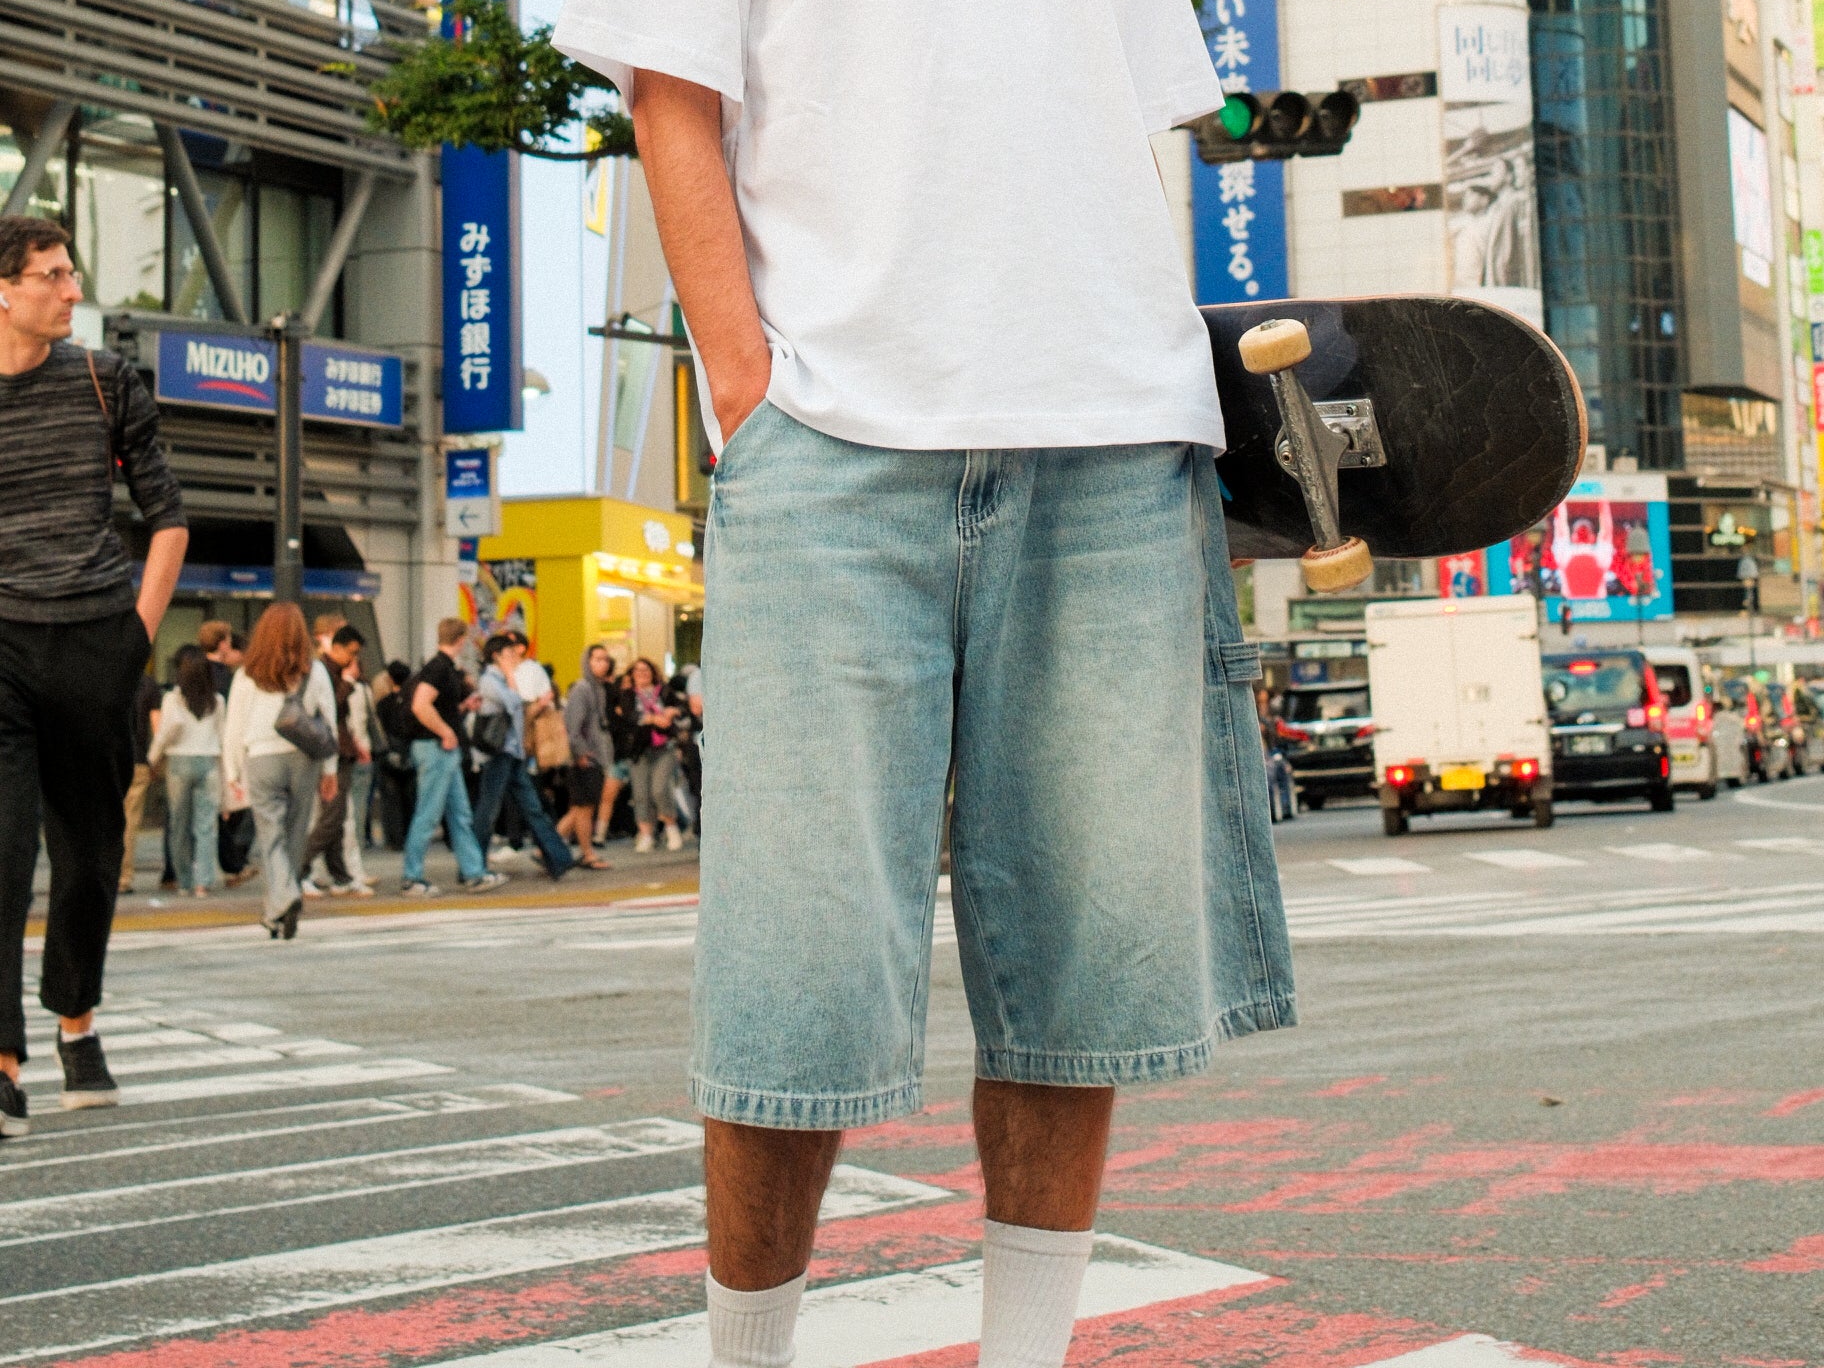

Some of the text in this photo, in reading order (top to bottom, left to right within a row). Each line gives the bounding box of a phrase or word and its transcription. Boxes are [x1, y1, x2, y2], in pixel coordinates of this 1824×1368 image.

[459, 222, 492, 390] みずほ銀行
[186, 340, 270, 384] MIZUHO
